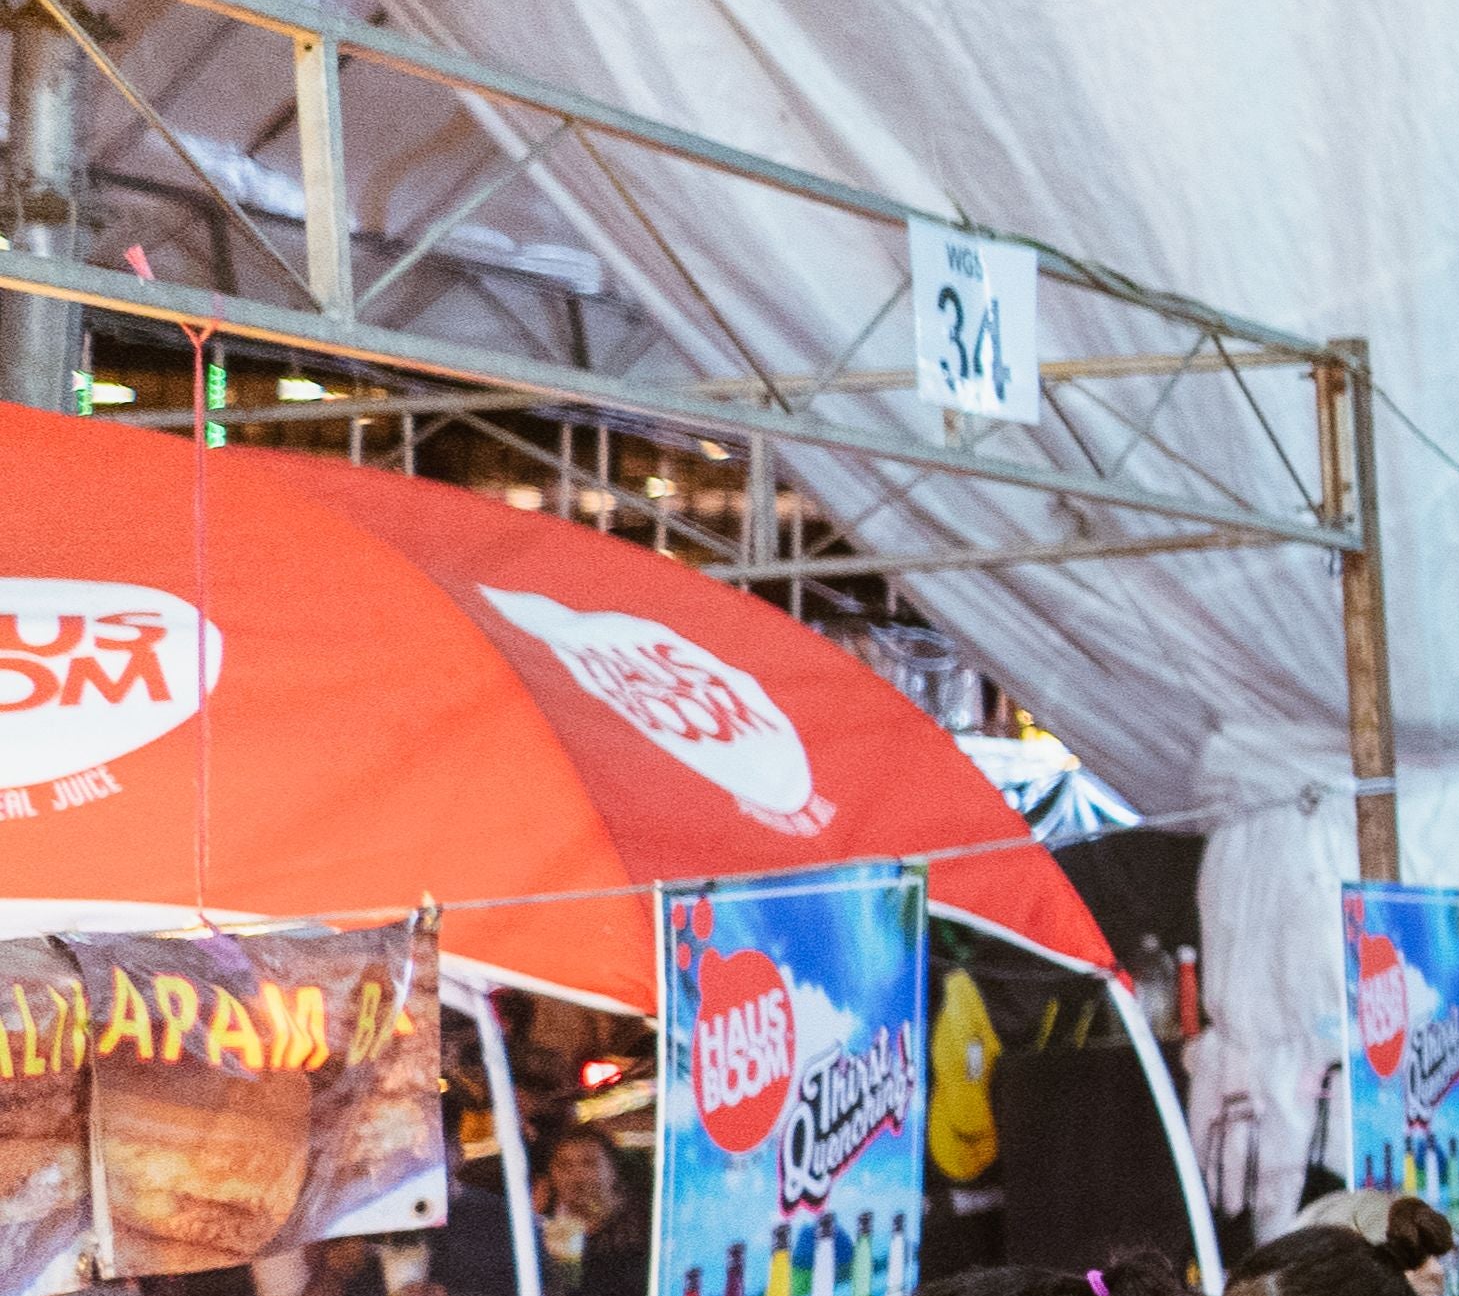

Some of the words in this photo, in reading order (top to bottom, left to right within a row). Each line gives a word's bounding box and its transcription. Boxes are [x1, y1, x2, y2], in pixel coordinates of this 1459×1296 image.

[0, 611, 168, 659] US
[0, 653, 173, 713] OM
[0, 786, 39, 822] EAL
[51, 765, 123, 812] JUICE
[99, 966, 330, 1073] APAM
[700, 987, 786, 1070] HAUS
[702, 1025, 791, 1114] BOOM
